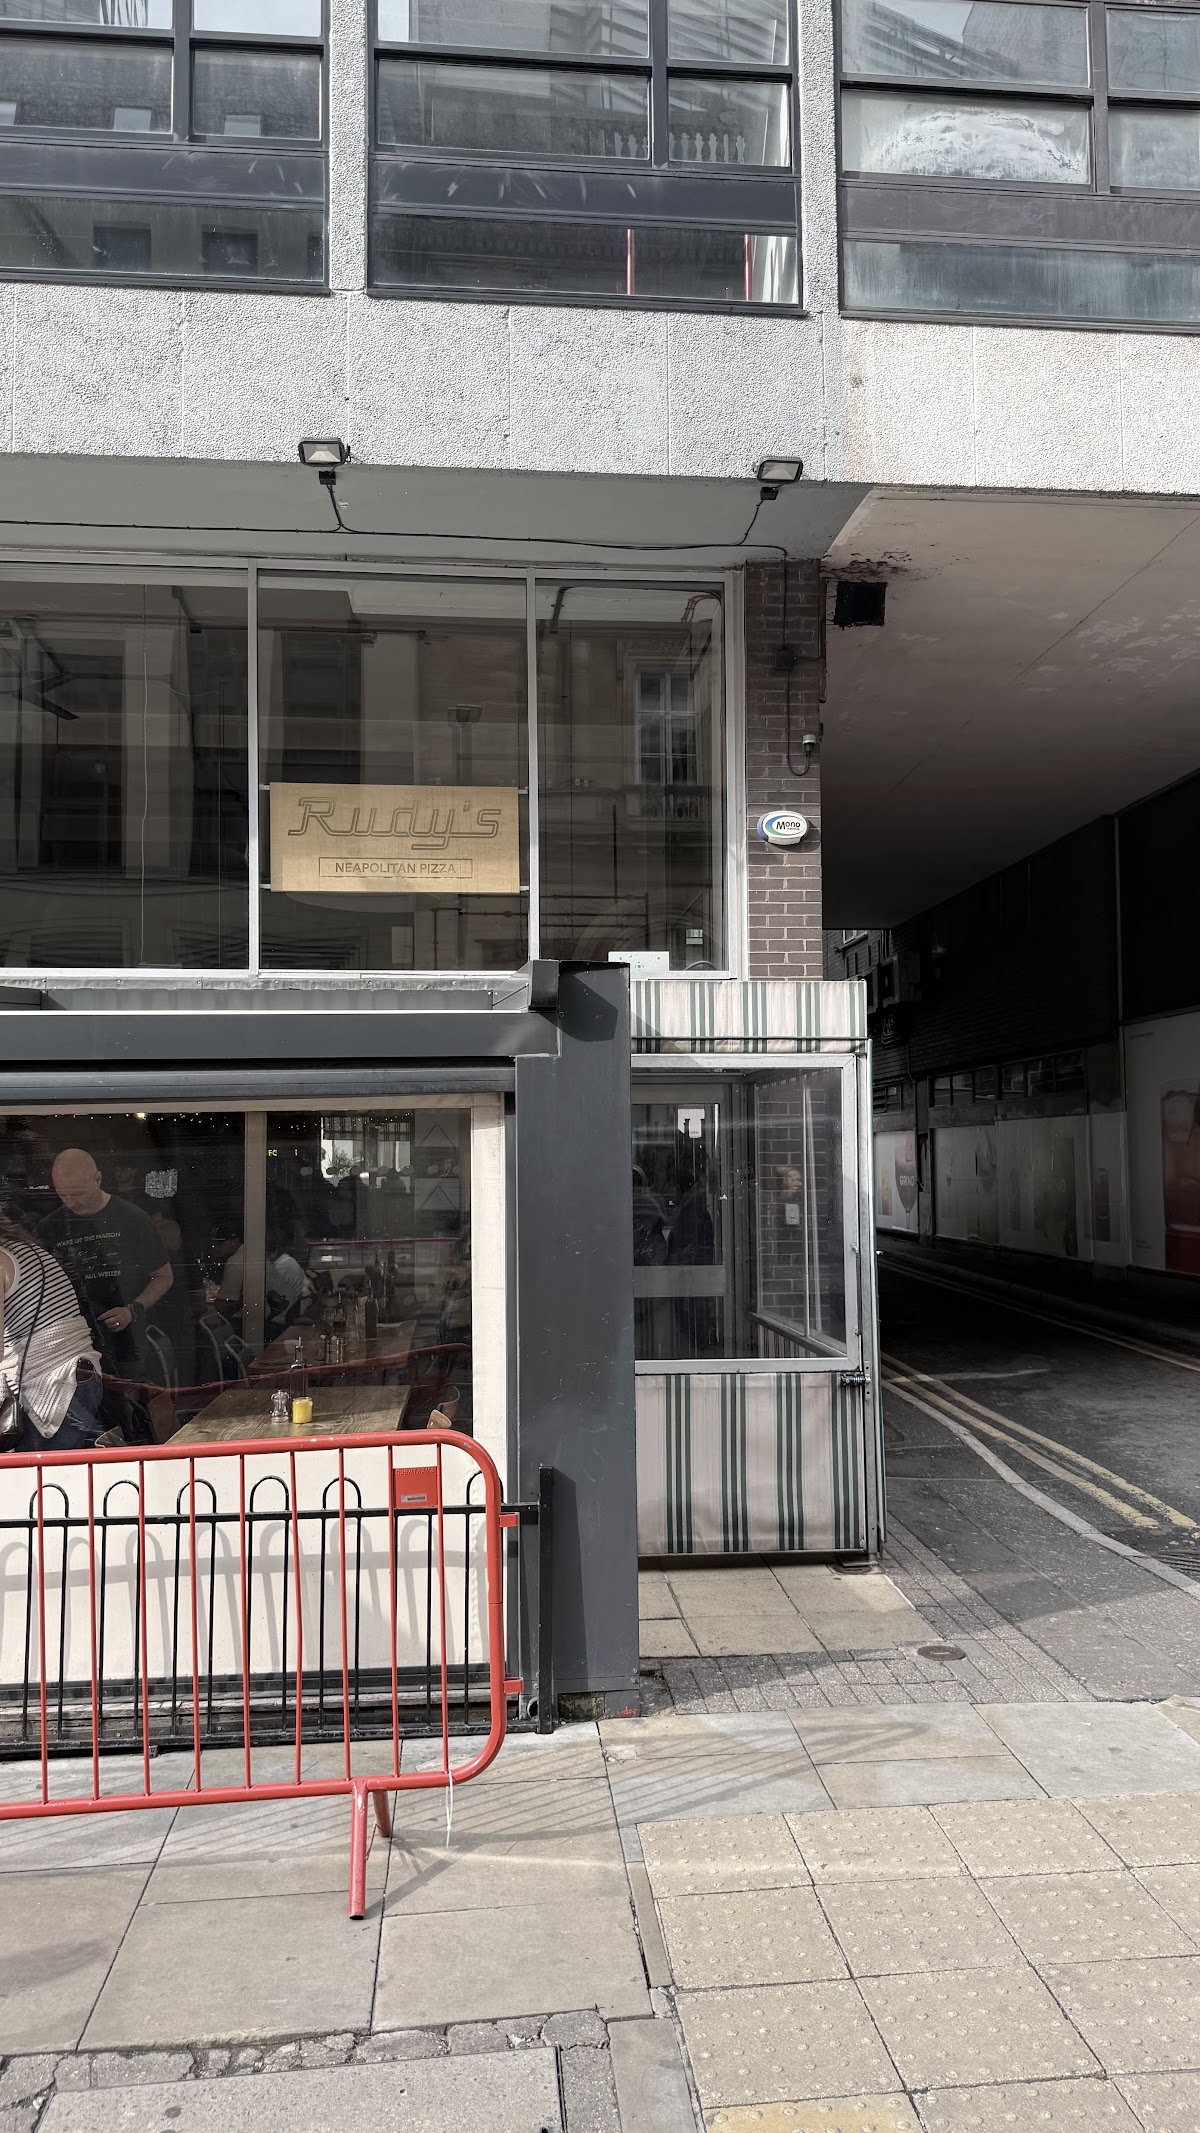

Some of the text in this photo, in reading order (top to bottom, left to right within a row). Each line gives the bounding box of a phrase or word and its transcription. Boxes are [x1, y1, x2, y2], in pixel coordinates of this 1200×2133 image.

[288, 797, 502, 851] Rudy's
[776, 821, 801, 830] Mono
[335, 862, 456, 874] NEAPOLITAN PIZZA
[899, 1175, 915, 1186] GRIND
[84, 1234, 95, 1242] THE
[96, 1232, 121, 1240] NATION
